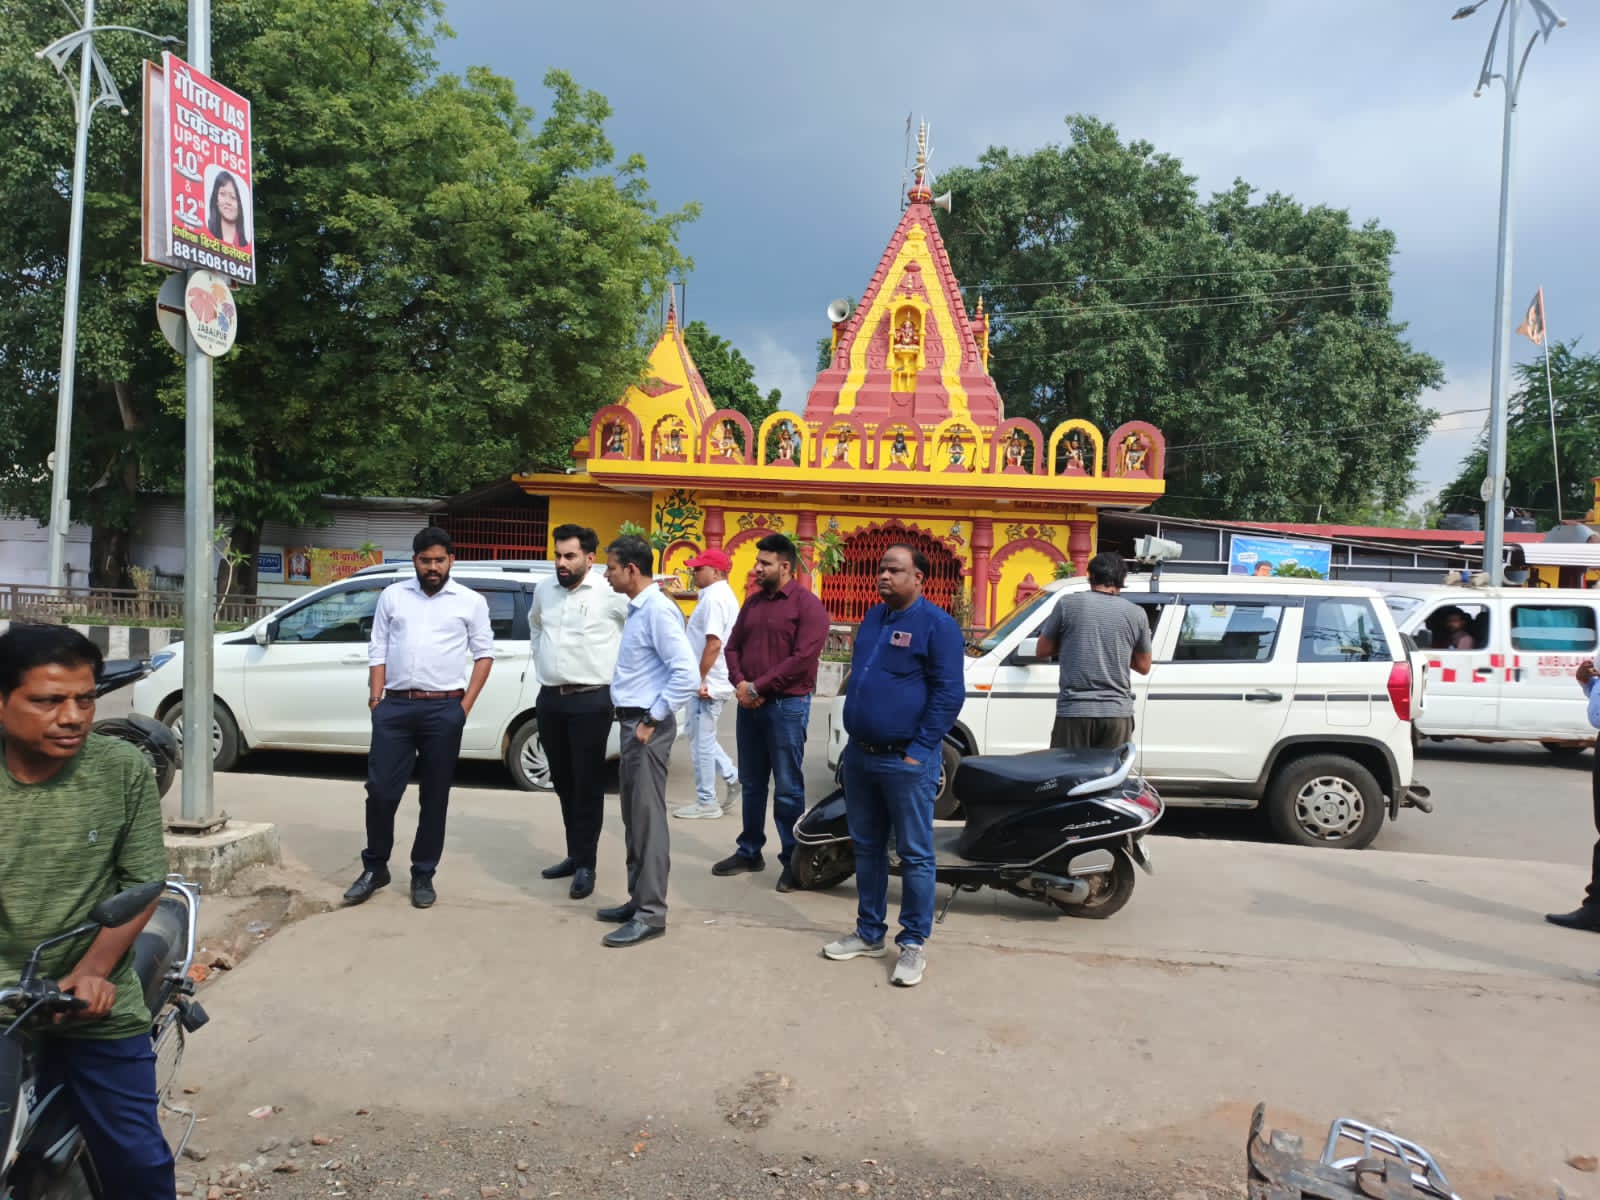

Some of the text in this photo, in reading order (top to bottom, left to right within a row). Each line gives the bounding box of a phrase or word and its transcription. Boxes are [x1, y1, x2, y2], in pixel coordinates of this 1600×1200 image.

[174, 66, 245, 131] गौतम IAS
[174, 123, 246, 174] UPSC PSC
[175, 103, 244, 156] एकेडमी
[174, 241, 252, 281] 8815081947
